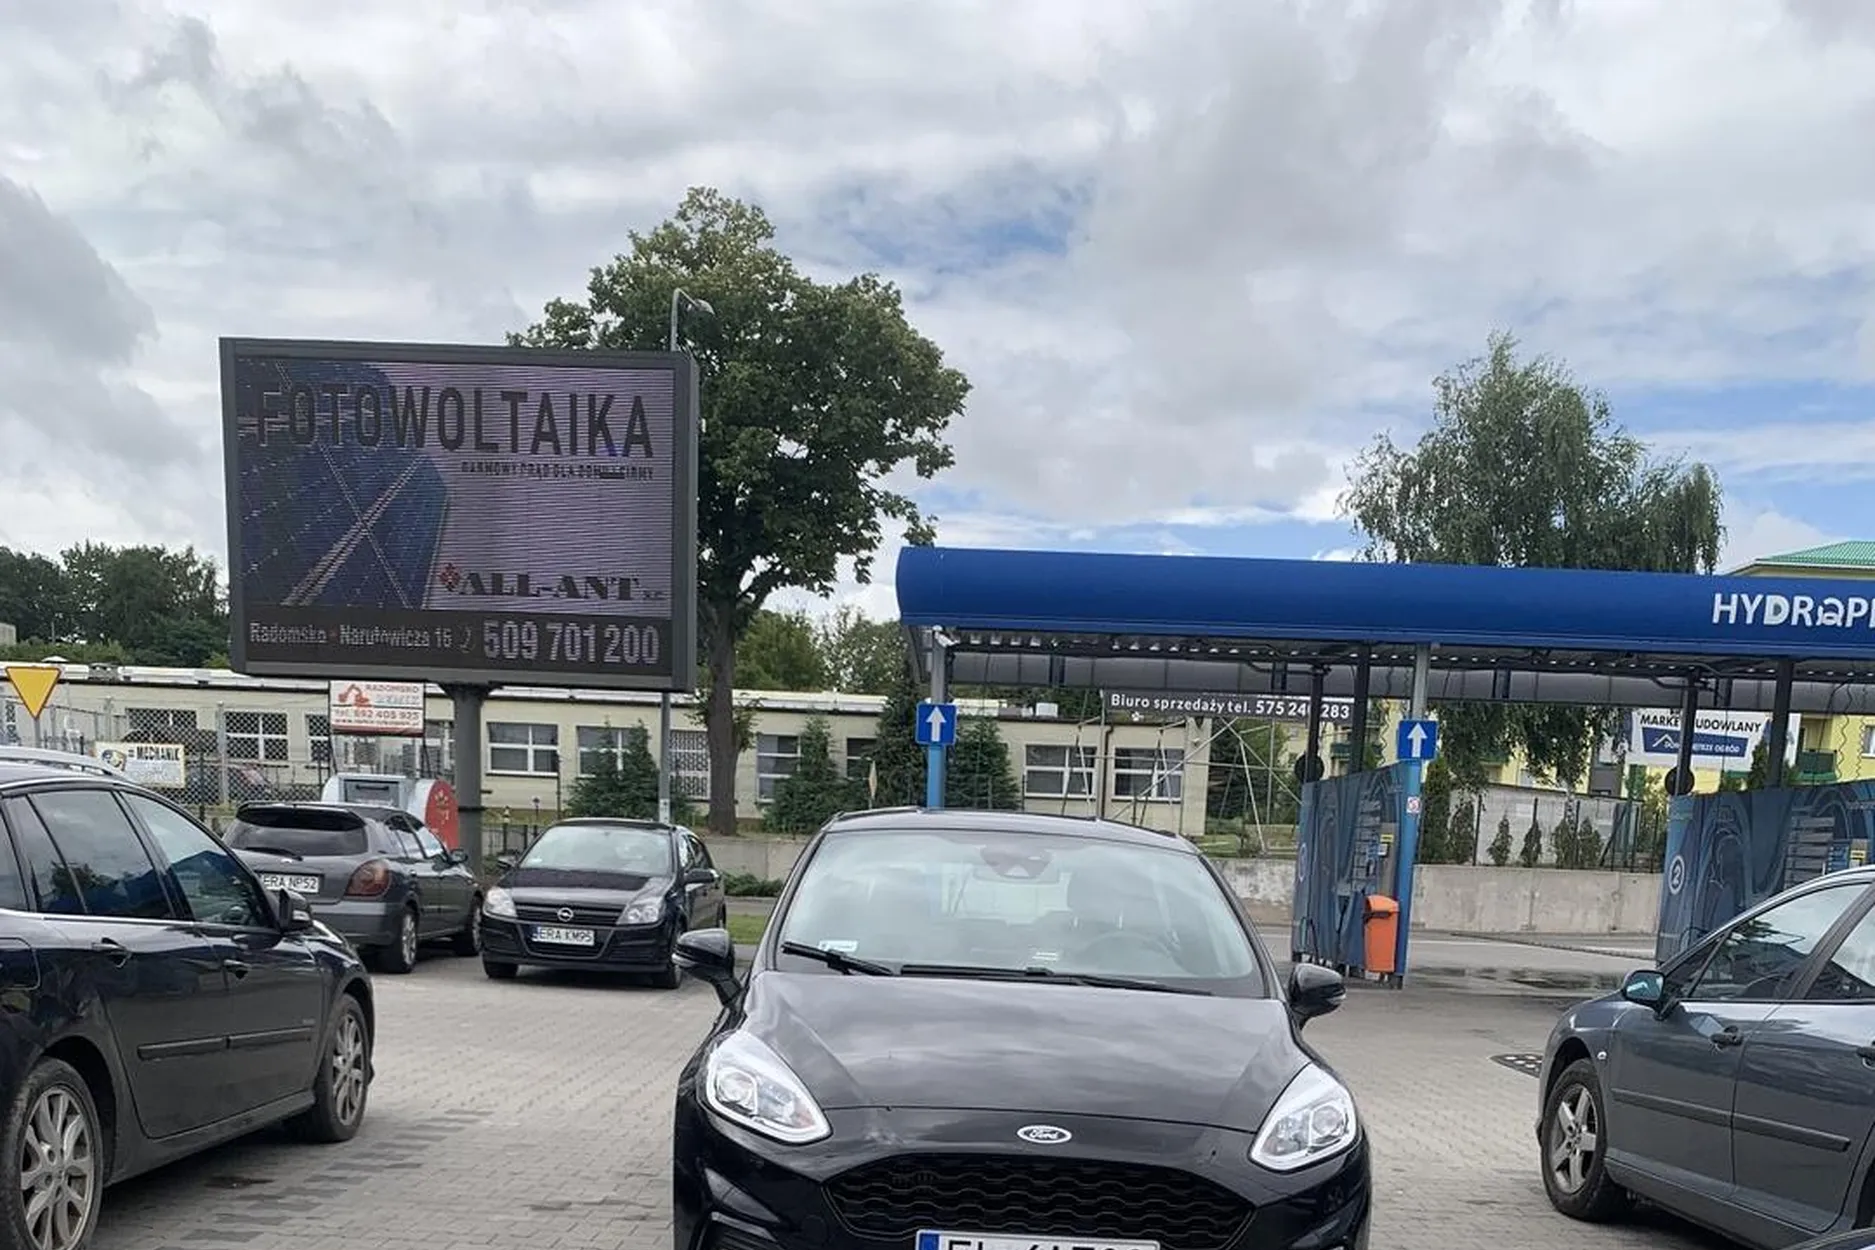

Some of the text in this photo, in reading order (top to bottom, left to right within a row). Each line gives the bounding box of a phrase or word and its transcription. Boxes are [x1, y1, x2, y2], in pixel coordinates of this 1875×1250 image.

[258, 382, 654, 458] FOTOWOLTAIKA
[459, 572, 640, 601] ALL-ANT
[250, 622, 327, 643] Radomsko
[340, 624, 430, 647] Narutowicza
[484, 620, 538, 660] 509
[546, 622, 597, 662] 701
[603, 624, 660, 664] 200
[1111, 693, 1350, 719] Biuro sprzedaży tel. 575 24 283
[1640, 714, 1761, 733] MARKE UDOWLANY
